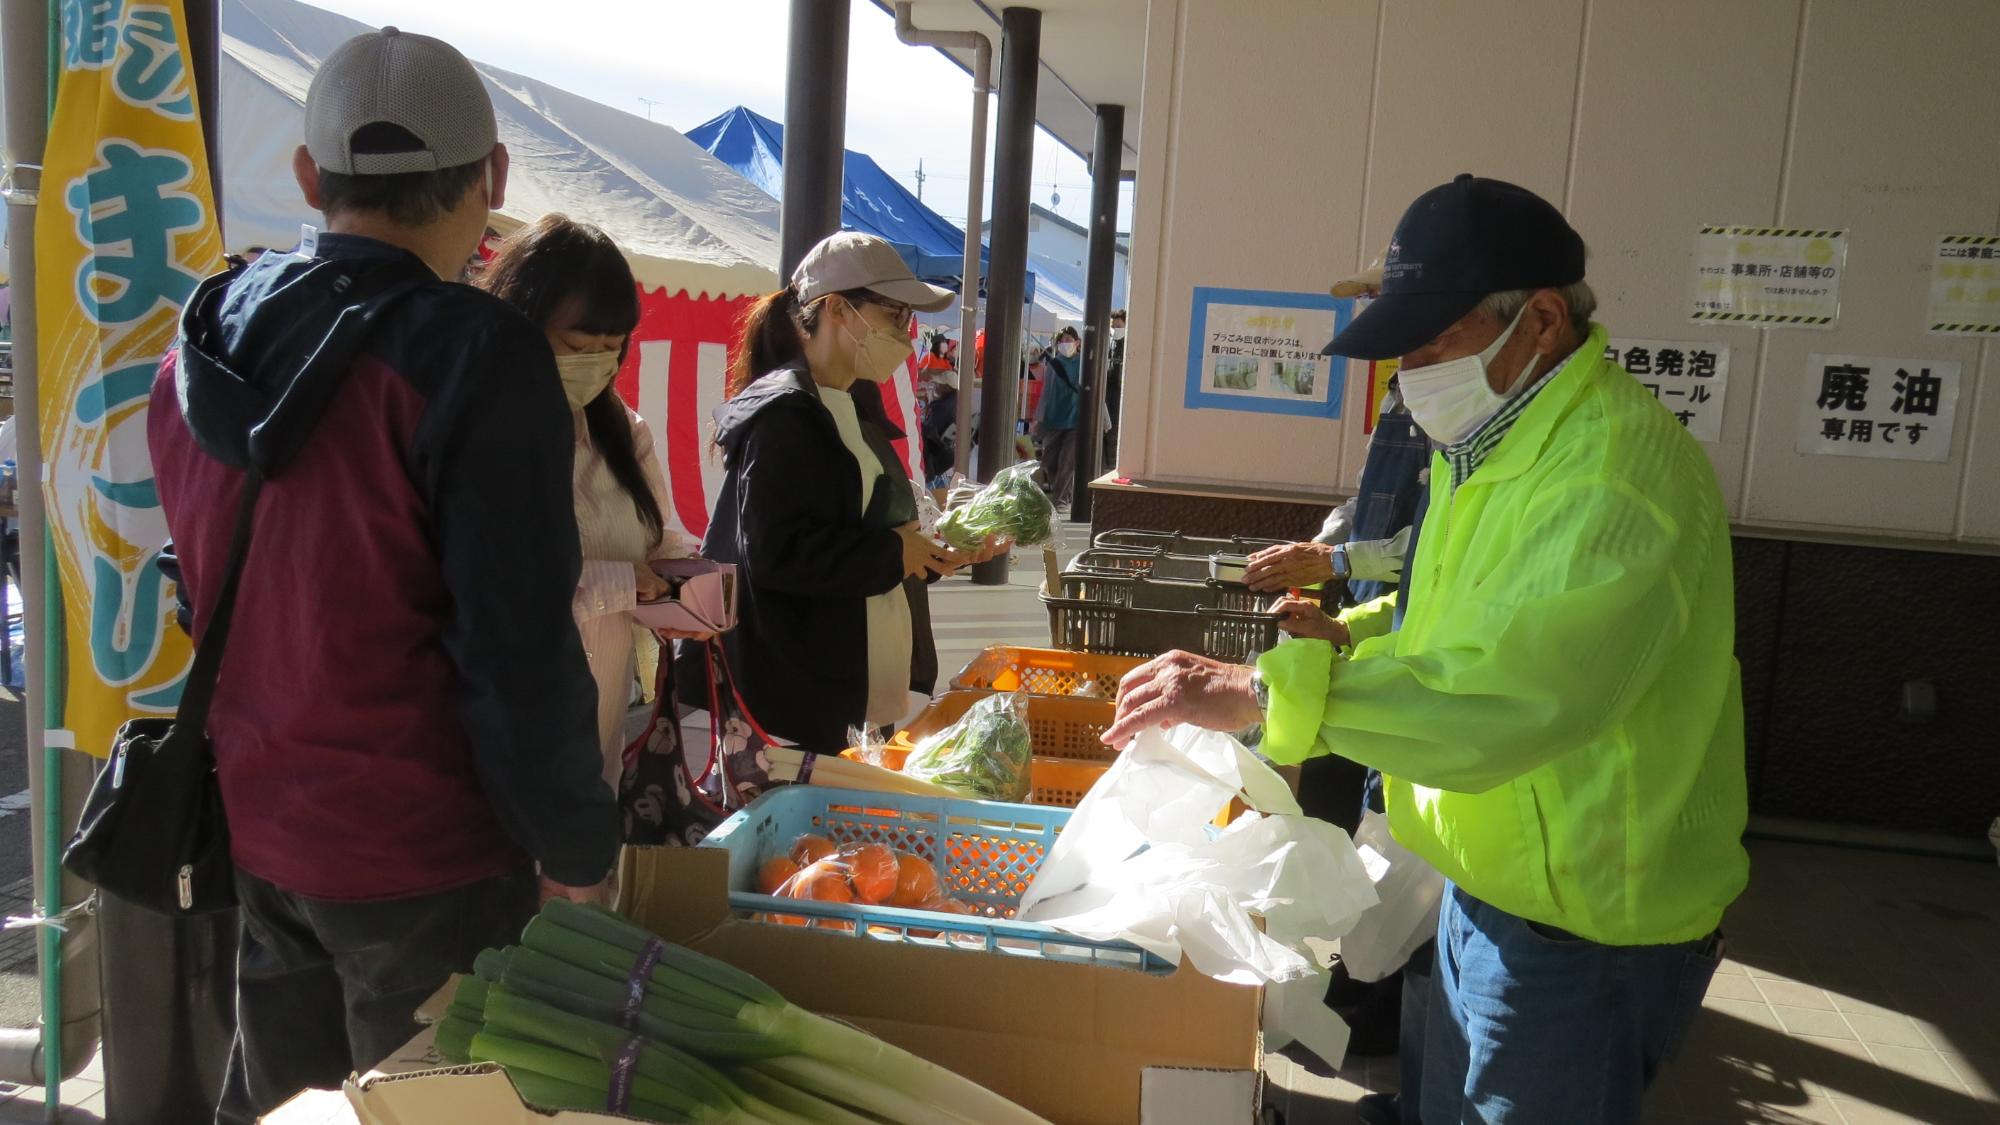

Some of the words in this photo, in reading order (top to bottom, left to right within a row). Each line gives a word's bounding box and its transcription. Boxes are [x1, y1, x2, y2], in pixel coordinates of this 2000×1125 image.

[1731, 263, 1836, 279] 事業所・店舗等の
[1819, 417, 1930, 445] 専用です
